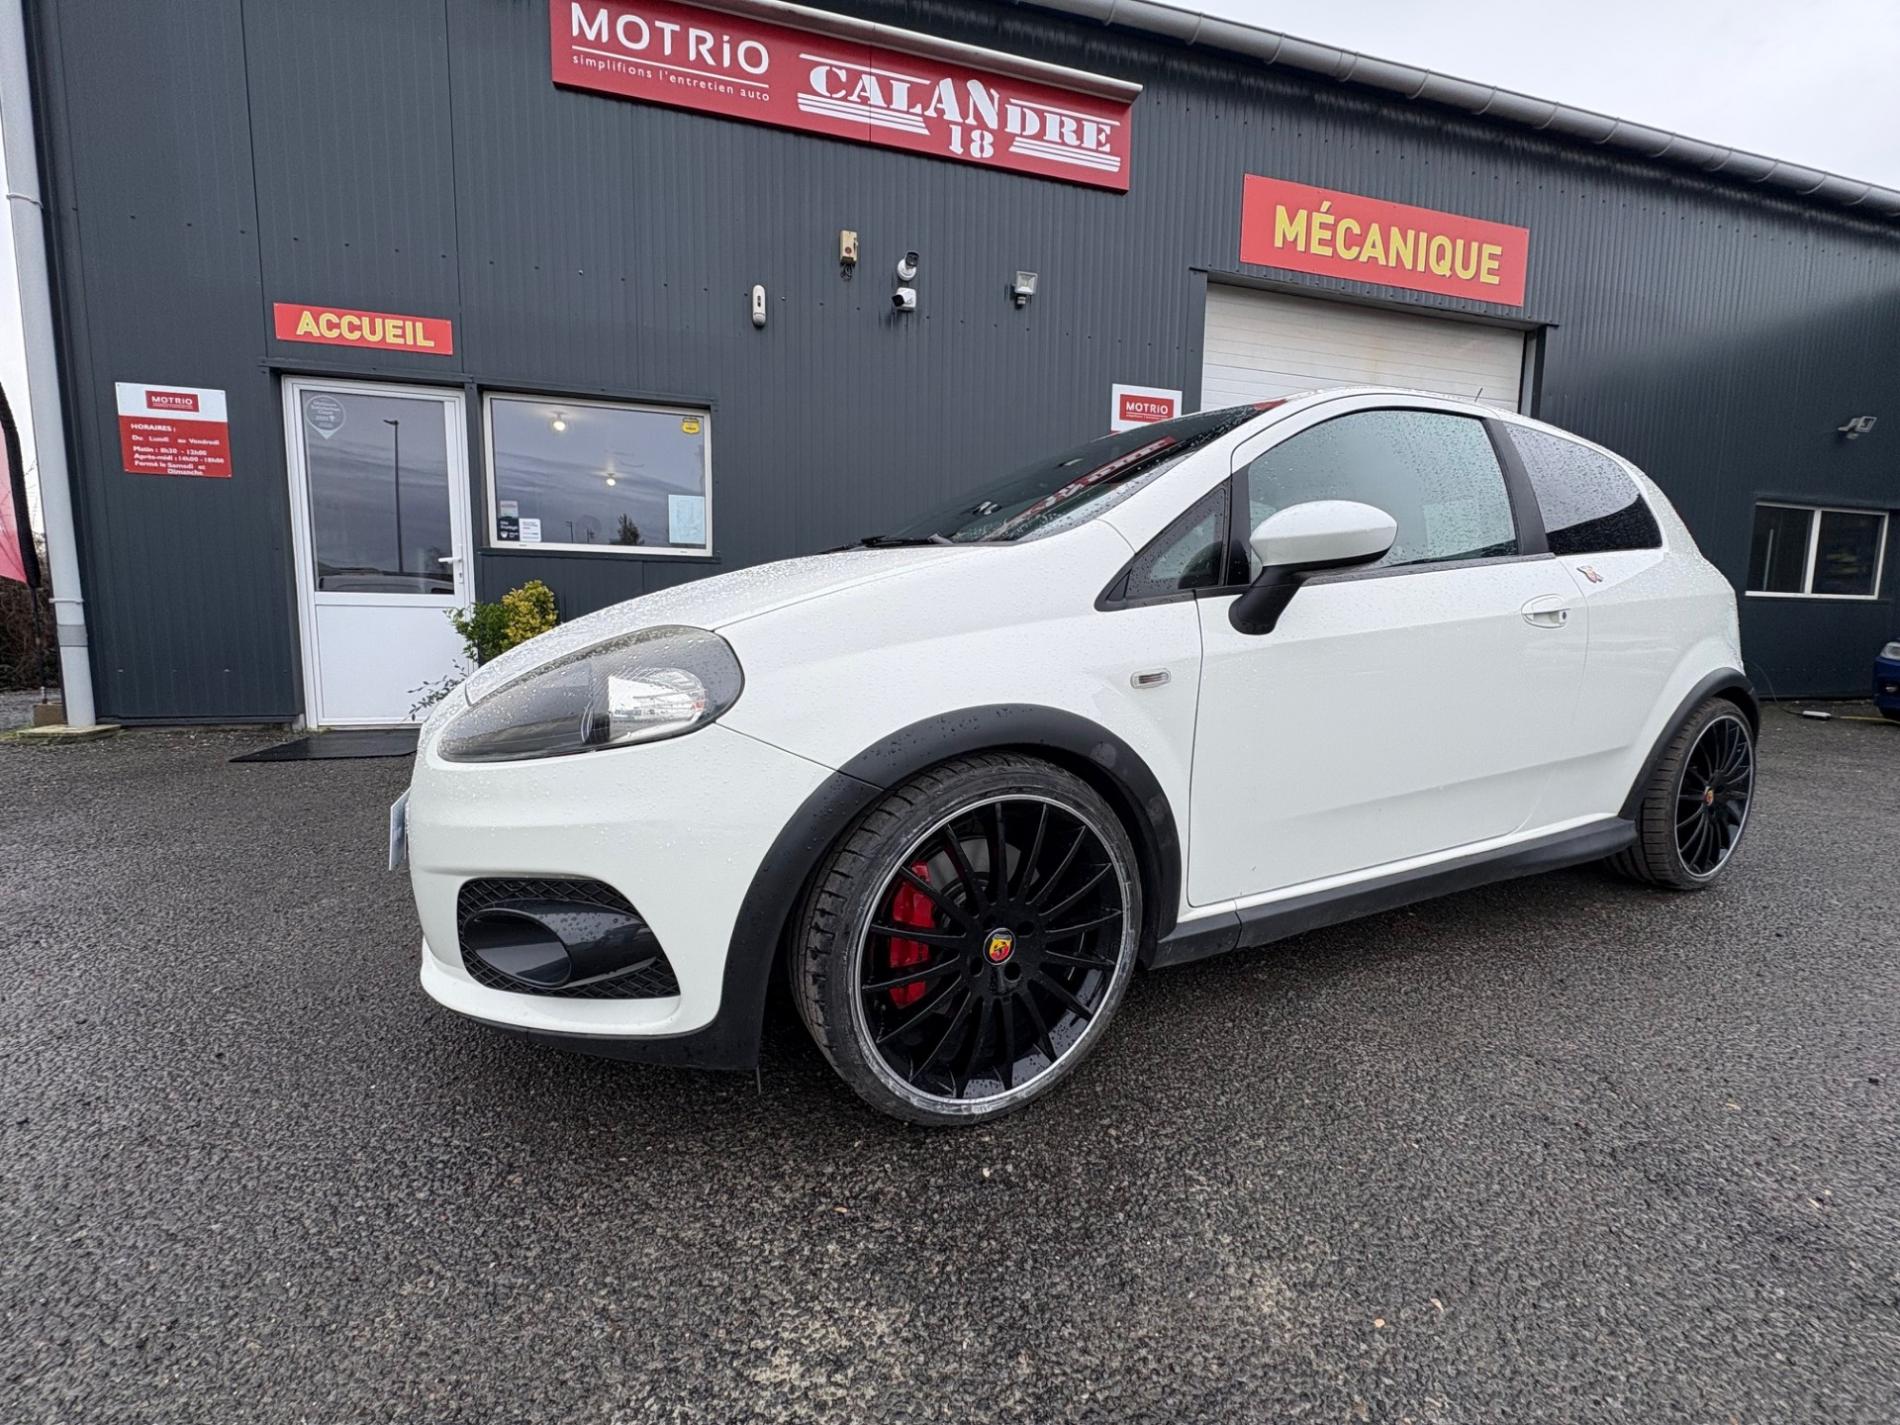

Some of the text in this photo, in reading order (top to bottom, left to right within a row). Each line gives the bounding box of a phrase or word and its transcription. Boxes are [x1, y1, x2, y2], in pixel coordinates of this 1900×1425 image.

[573, 54, 770, 102] simplifions l'entretien auto
[809, 65, 1111, 153] CALANDRE
[948, 124, 995, 159] 18
[1274, 200, 1503, 285] MÉCANIQUE
[296, 310, 435, 348] ACCUEIL
[130, 423, 172, 432] HORAIRES
[188, 438, 220, 446] Vendredi
